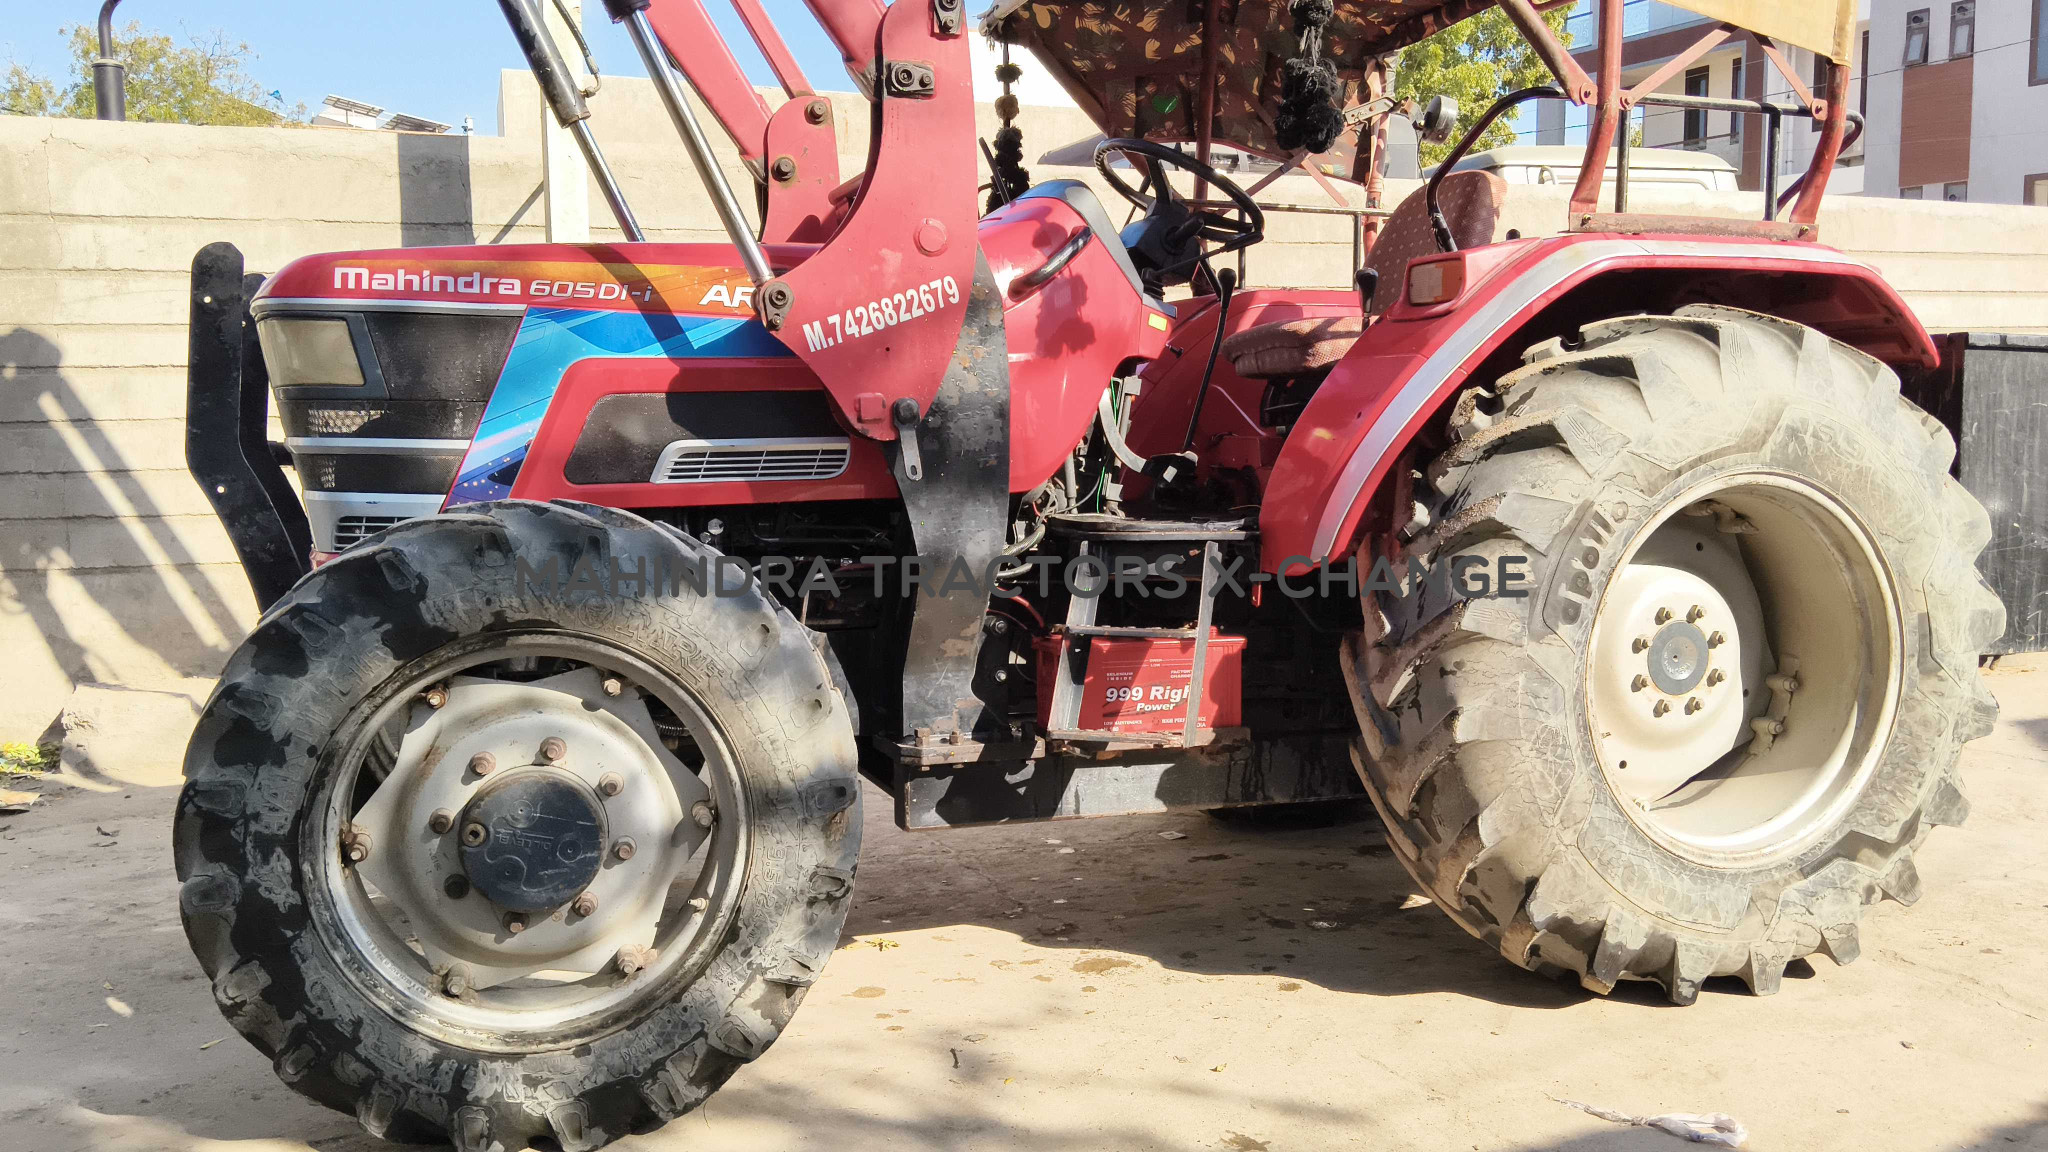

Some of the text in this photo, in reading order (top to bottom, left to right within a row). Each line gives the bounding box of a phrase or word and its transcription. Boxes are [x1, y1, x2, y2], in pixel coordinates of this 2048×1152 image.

[334, 267, 521, 295] Mahindra
[802, 275, 960, 352] M.7426822679
[1106, 686, 1143, 702] 999
[1136, 702, 1175, 712] Power
